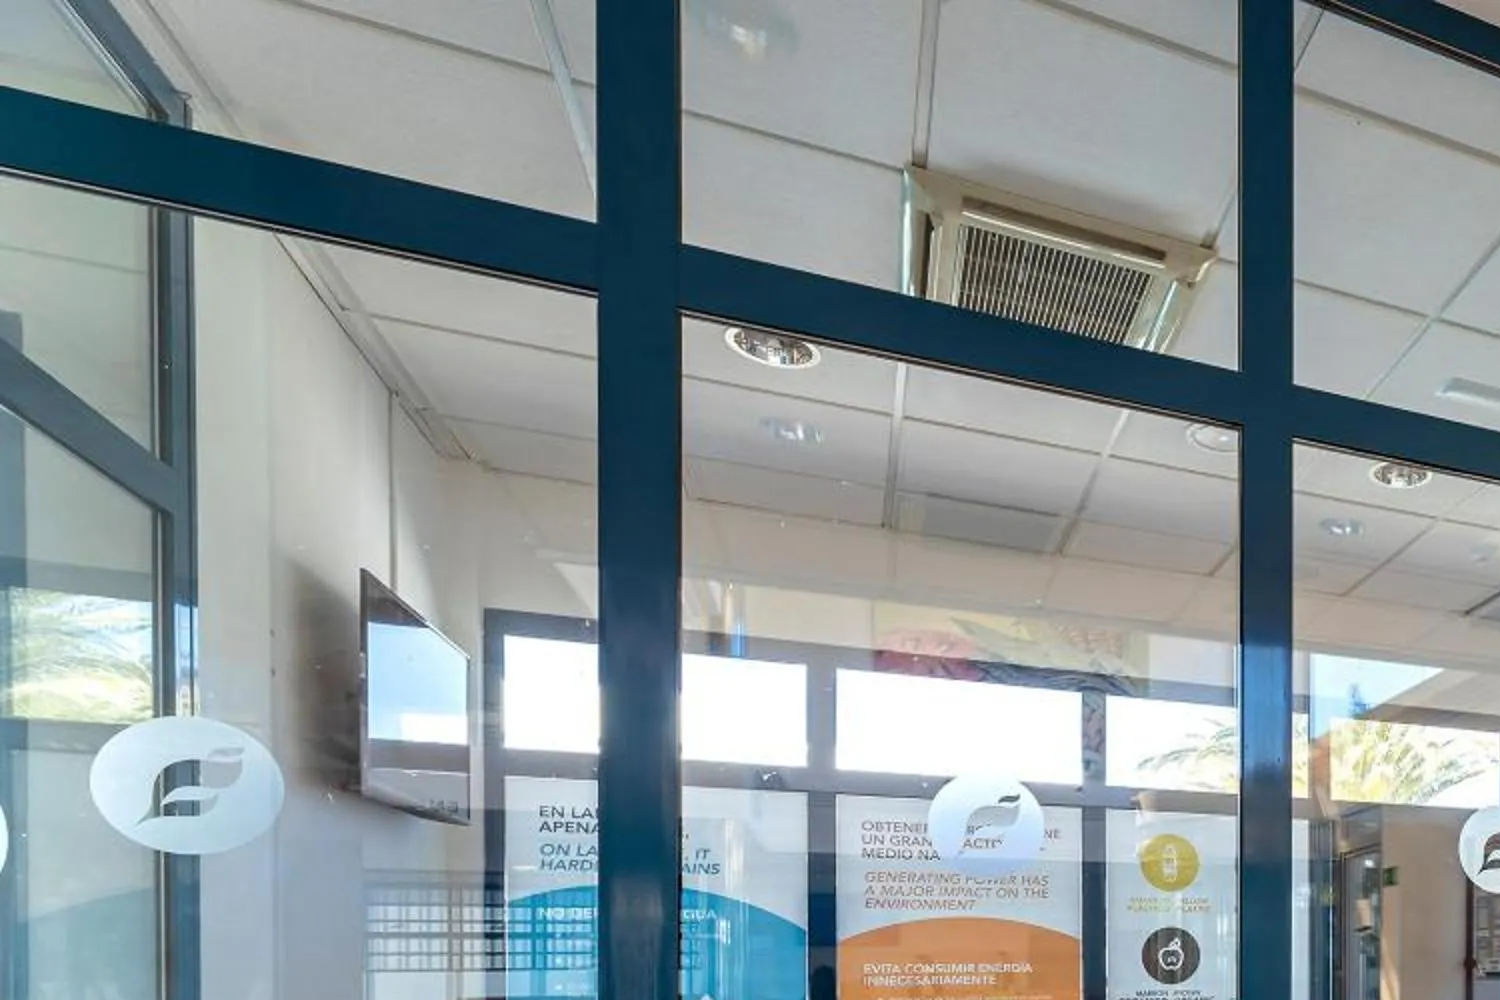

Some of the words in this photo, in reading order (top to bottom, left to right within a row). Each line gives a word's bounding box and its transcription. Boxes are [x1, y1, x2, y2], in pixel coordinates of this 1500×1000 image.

[539, 805, 565, 819] EN
[539, 820, 600, 833] APENA
[861, 833, 885, 846] UN
[889, 835, 933, 848] GRAN
[540, 843, 571, 857] ON
[861, 847, 913, 861] MEDIO
[540, 858, 593, 872] HARD
[681, 862, 721, 875] AINS
[1021, 874, 1051, 888] HAS
[995, 887, 1019, 899] ON
[1022, 887, 1050, 900] THE
